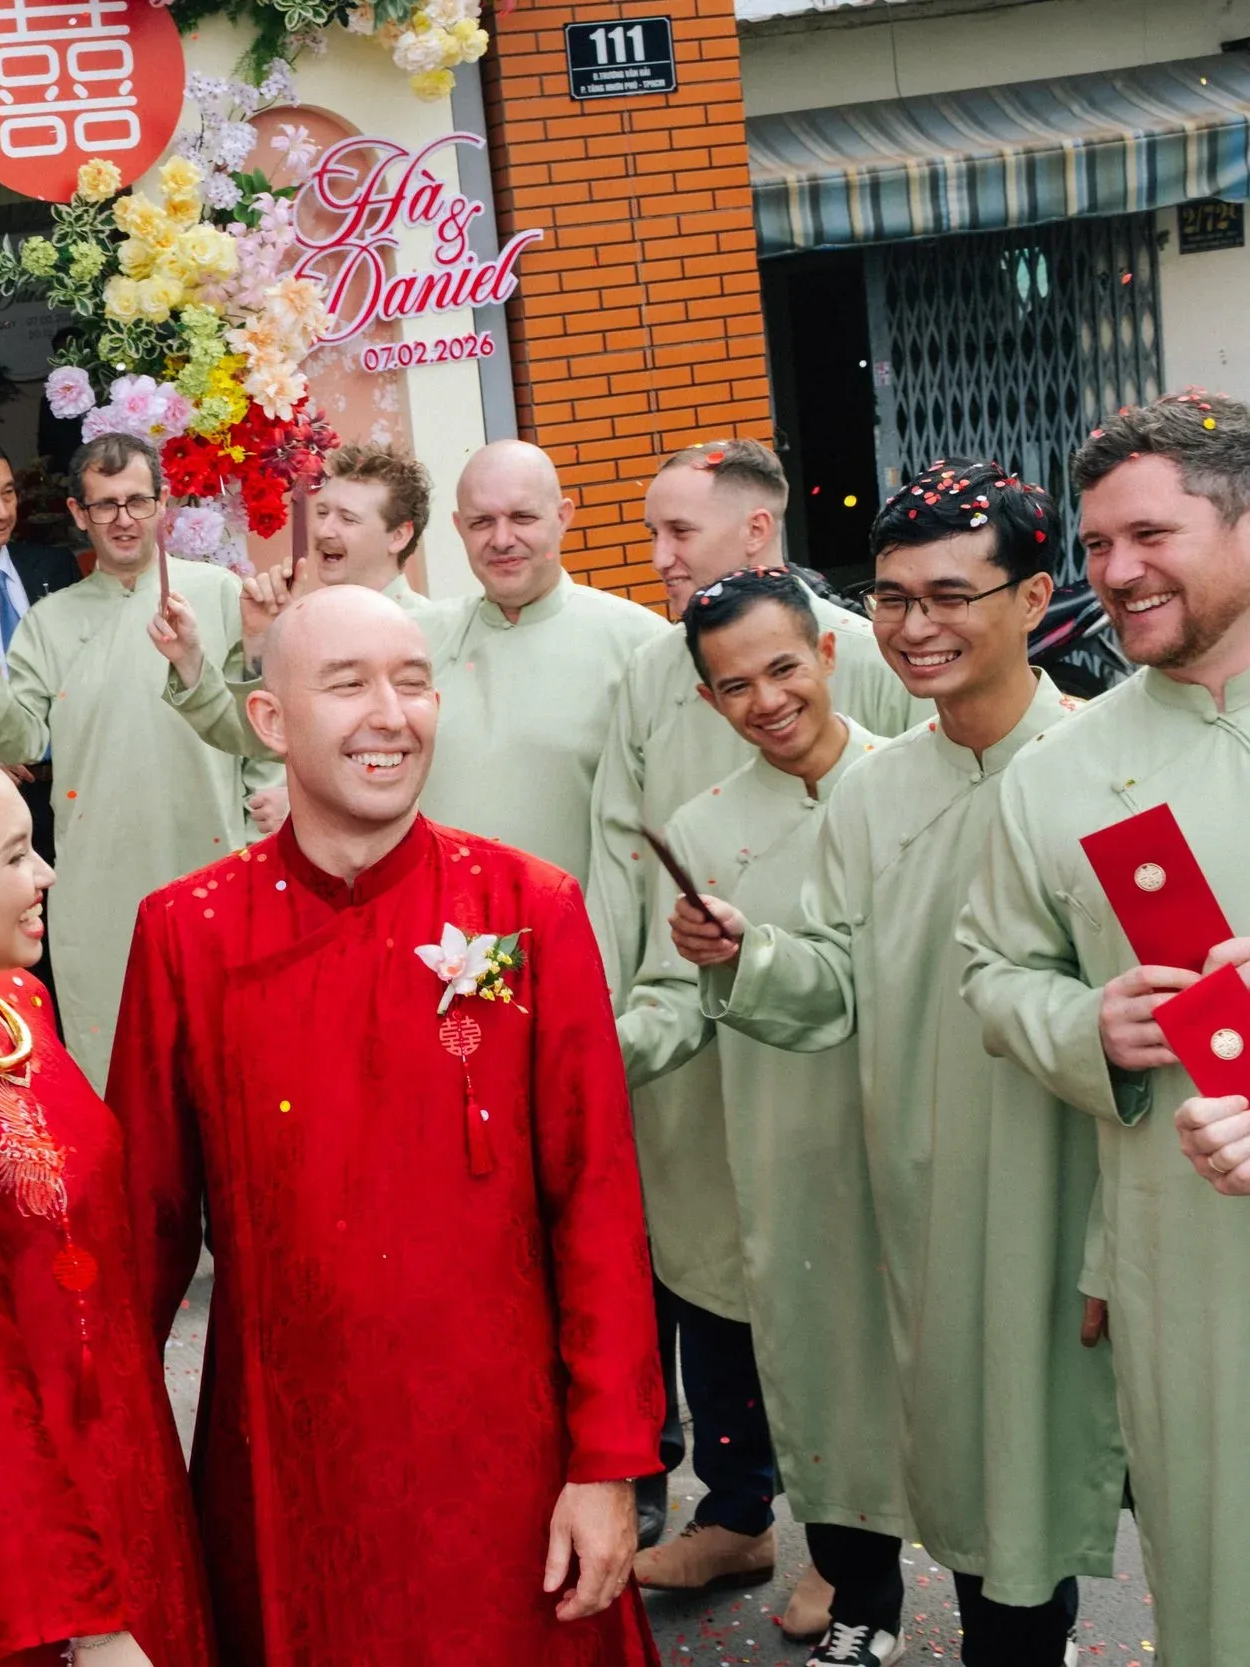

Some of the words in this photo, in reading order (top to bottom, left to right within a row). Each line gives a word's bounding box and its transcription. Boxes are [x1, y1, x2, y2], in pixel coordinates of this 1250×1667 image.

[589, 25, 645, 64] 111
[295, 134, 484, 250] Hà
[435, 197, 482, 265] &
[295, 233, 542, 346] Daniel
[363, 333, 494, 372] 07.02.2026
